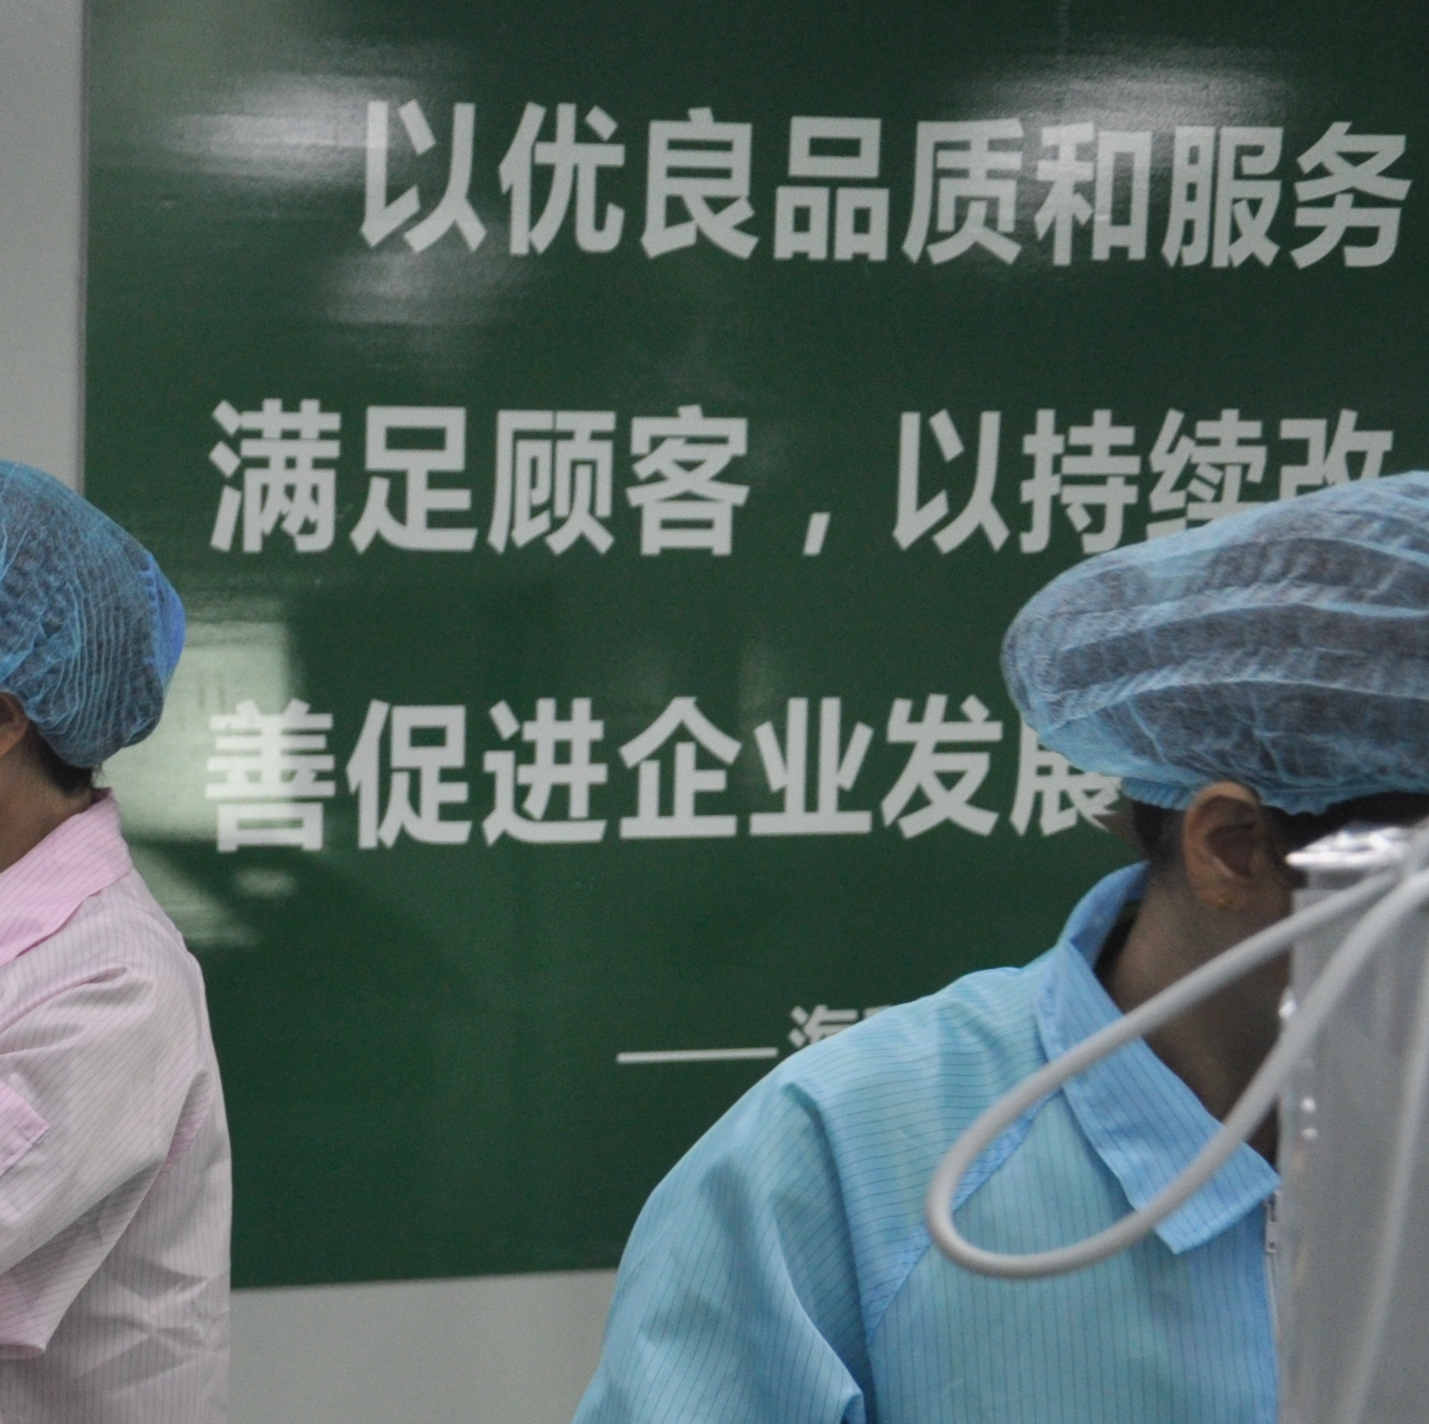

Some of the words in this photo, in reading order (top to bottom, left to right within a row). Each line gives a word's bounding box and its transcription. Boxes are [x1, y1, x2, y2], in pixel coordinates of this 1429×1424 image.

[359, 98, 1411, 268] 以优良品质和服务
[205, 694, 1122, 853] 善促进企业发展
